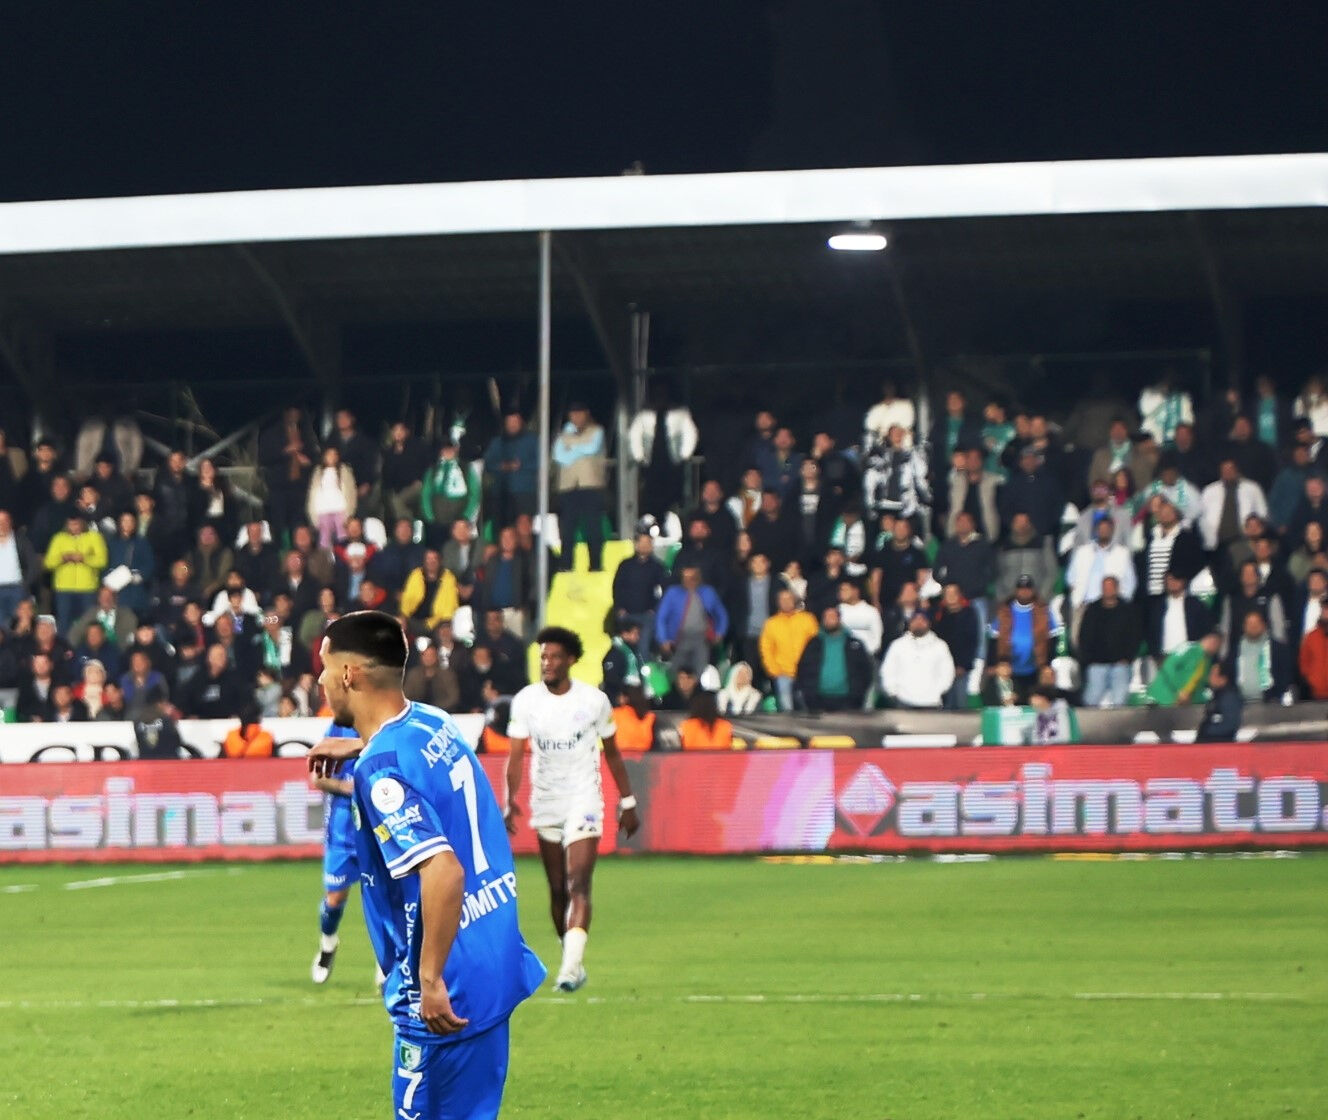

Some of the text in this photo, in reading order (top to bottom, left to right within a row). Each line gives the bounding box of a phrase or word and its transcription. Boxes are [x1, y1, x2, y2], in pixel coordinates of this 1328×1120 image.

[449, 754, 490, 875] 7
[897, 762, 1320, 837] asimato
[397, 1067, 423, 1110] 7
